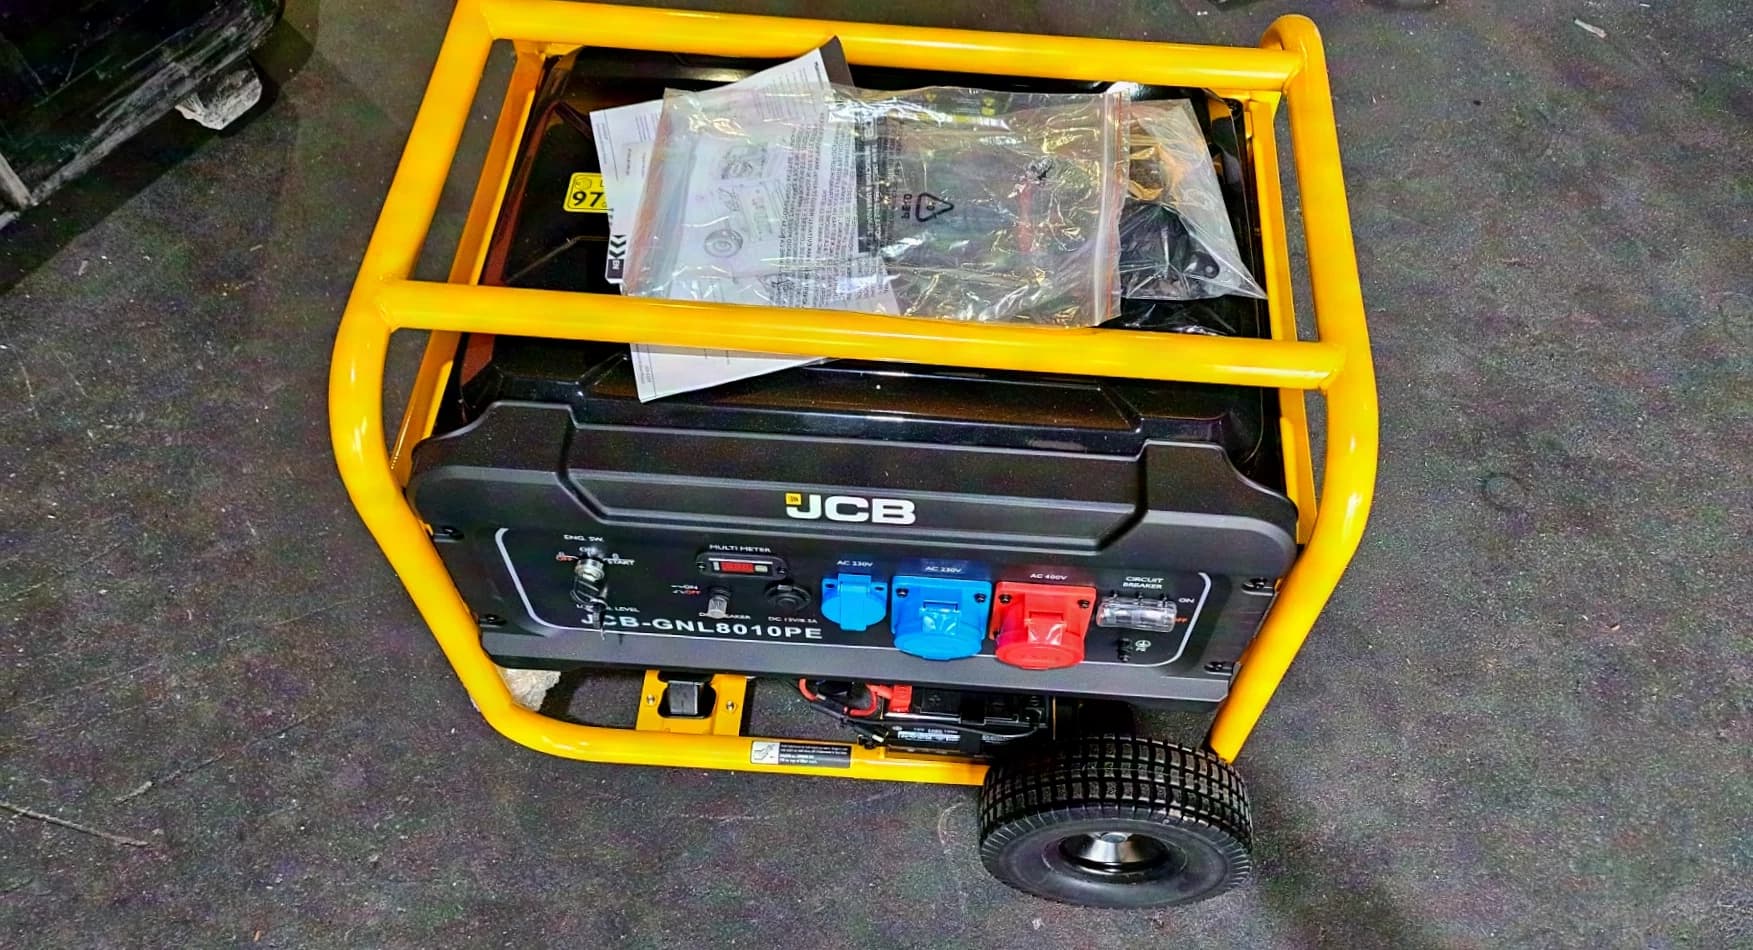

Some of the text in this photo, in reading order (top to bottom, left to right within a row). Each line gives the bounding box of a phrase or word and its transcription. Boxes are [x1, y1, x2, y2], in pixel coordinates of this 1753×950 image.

[572, 191, 604, 207] 97
[785, 492, 916, 525] JCB
[1123, 582, 1163, 590] BREAKER
